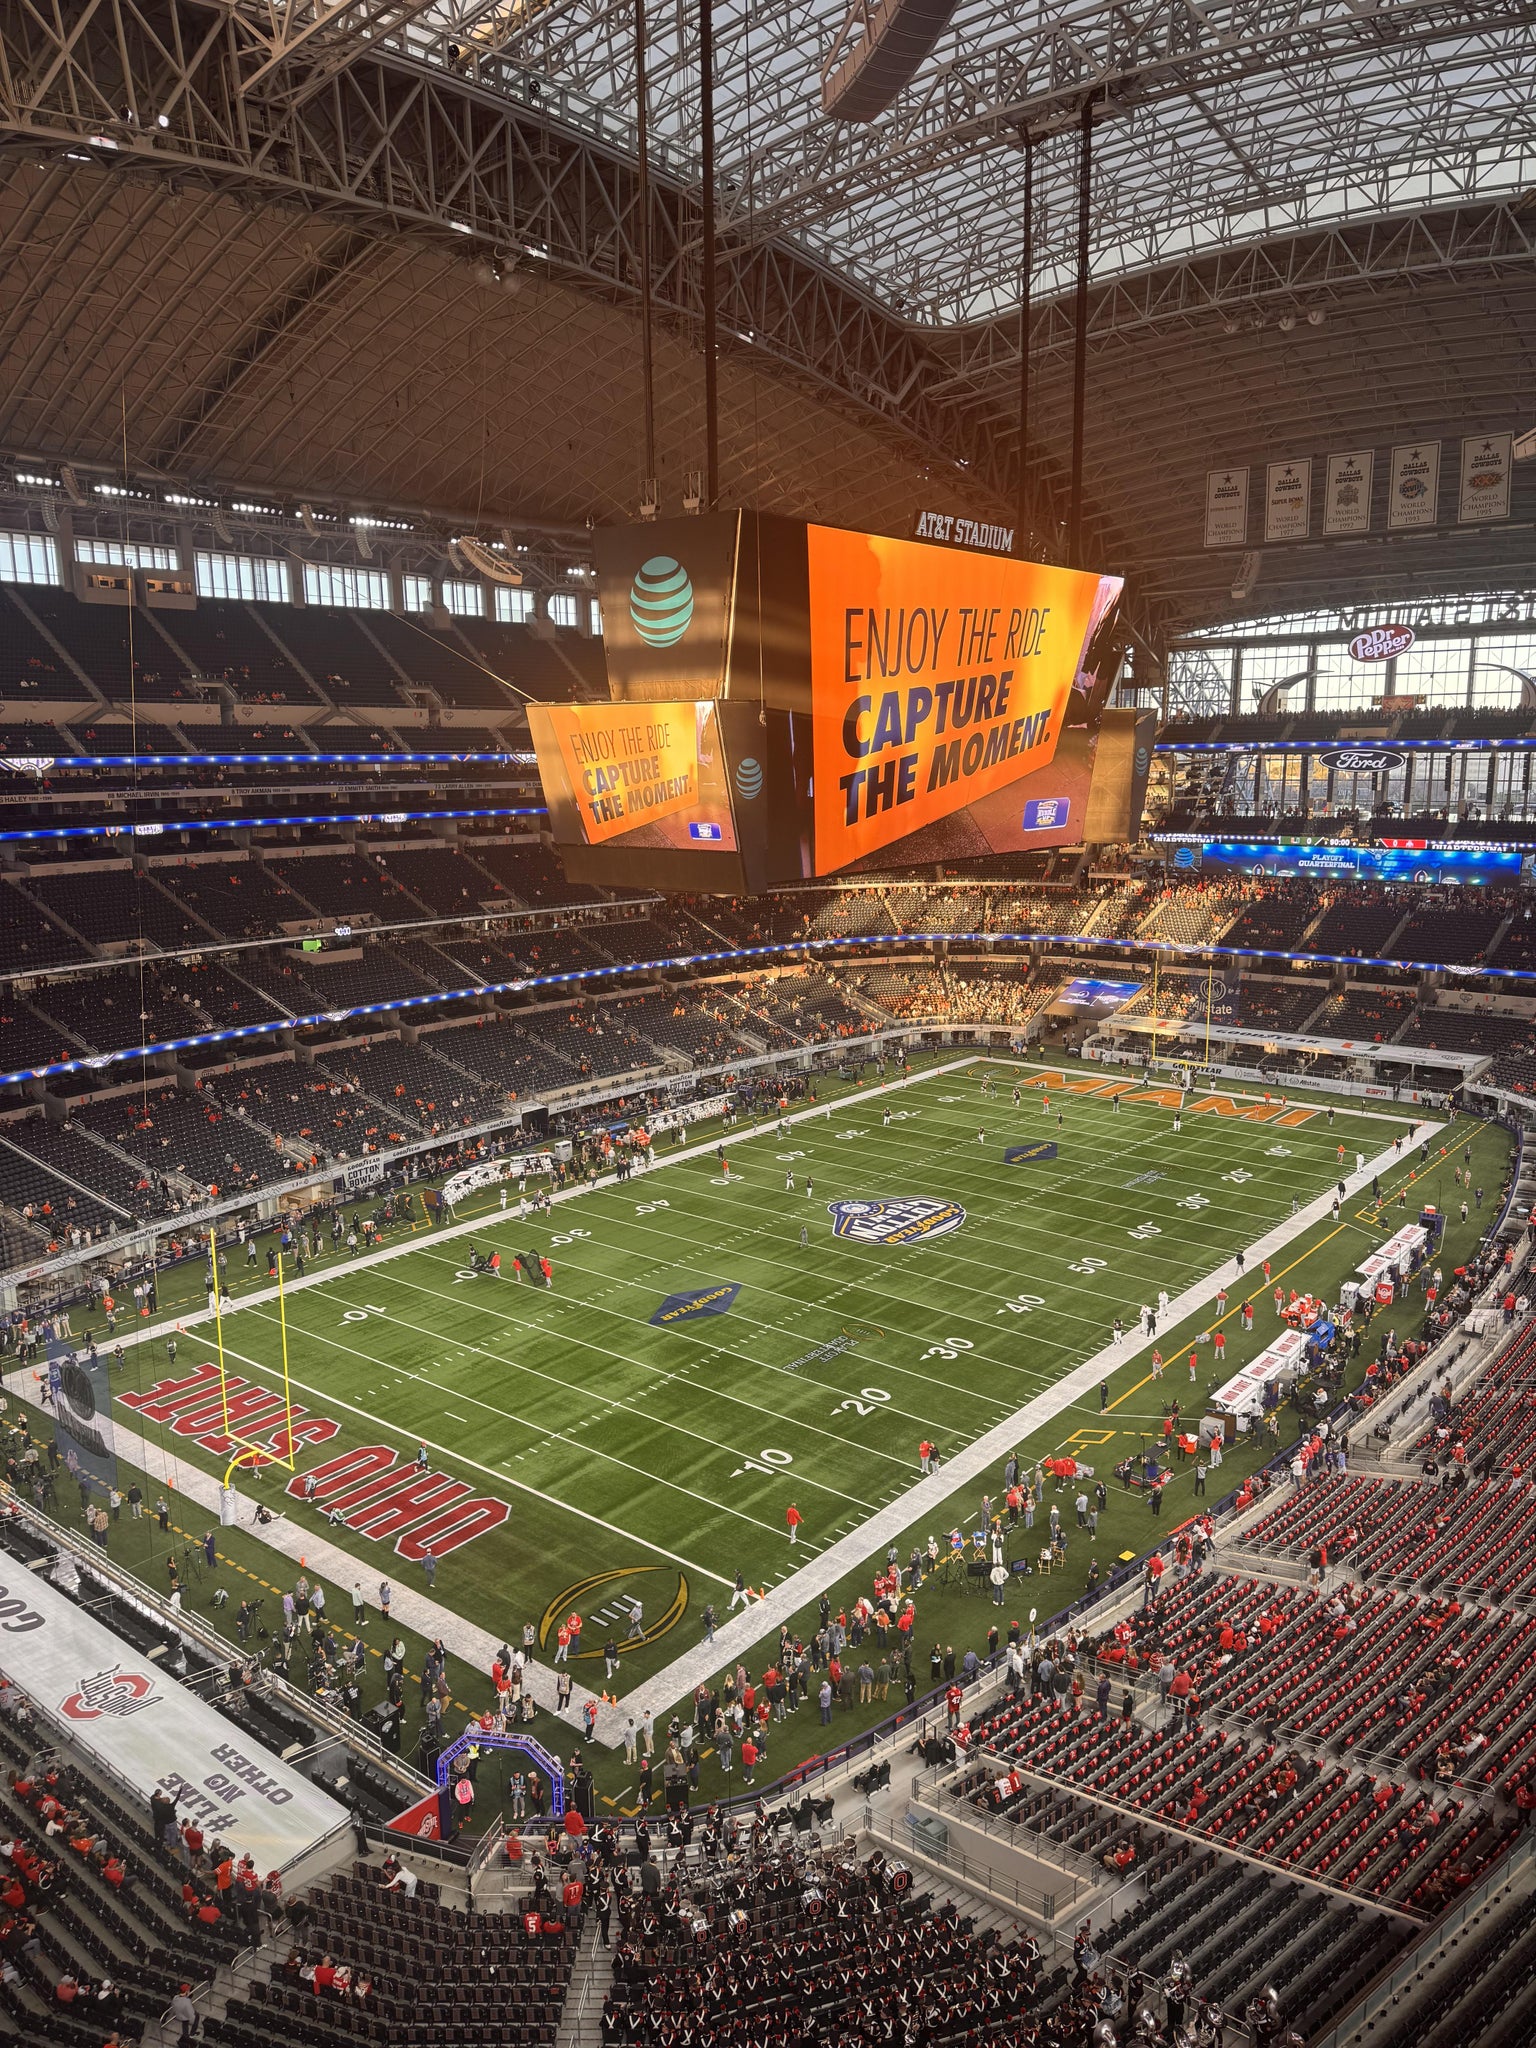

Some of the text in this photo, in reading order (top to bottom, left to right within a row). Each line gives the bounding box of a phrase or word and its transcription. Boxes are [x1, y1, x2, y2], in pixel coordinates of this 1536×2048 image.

[1403, 461, 1427, 469] DALLAS
[1471, 459, 1502, 469] COWBOYS
[1474, 453, 1500, 461] DALLAS
[1335, 476, 1363, 484] COWBOYS
[1400, 468, 1430, 477] COWBOYS
[1214, 491, 1240, 499] COWBOYS
[1275, 484, 1302, 492] COWBOYS
[1400, 501, 1426, 509] WORLD
[1463, 501, 1506, 511] CHAMPIONS
[1471, 494, 1498, 502] WORLD
[1328, 515, 1366, 524] CHAMPIONS
[1392, 508, 1433, 517] CHAMPIONS
[915, 511, 1014, 552] AT&T STADIUM
[1268, 522, 1306, 531] CHAMPIONS
[845, 608, 1050, 682] ENJOY THE RIDE
[1371, 629, 1395, 645] Dr
[1357, 634, 1410, 659] Pepper
[842, 670, 1014, 759] CAPTURE
[569, 723, 671, 765] ENJOY THE RIDE
[839, 709, 1052, 827] THE MOMENT.
[1336, 752, 1387, 769] Ford
[582, 755, 660, 797] CAPTURE
[5, 795, 27, 803] HALEY
[588, 774, 692, 825] THE MOMENT.
[1298, 860, 1356, 869] QUARTERFINAL
[1312, 854, 1344, 862] PLAYOFF
[1192, 1001, 1233, 1016] Allstate
[1216, 1028, 1321, 1045] GOODYEAR
[1299, 1080, 1321, 1088] Allstate
[1366, 1088, 1386, 1096] ESPN
[1018, 1071, 1321, 1127] MIAMI
[1264, 1147, 1292, 1157] 10
[347, 1157, 381, 1171] GOODYEAR
[347, 1164, 380, 1180] COTTON
[349, 1175, 374, 1187] BOWL
[709, 1173, 746, 1187] 50
[1221, 1170, 1253, 1183] 20
[635, 1199, 671, 1213] 40
[1176, 1195, 1210, 1210] 30
[850, 1200, 947, 1240] COTTON
[854, 1202, 911, 1226] BOWL
[884, 1207, 960, 1244] GOODYEAR
[1127, 1223, 1162, 1240] 40
[129, 1226, 162, 1242] GOODYEAR
[552, 1228, 593, 1244] 30
[26, 1267, 45, 1278] ESPN
[1067, 1257, 1108, 1274] 50
[660, 1287, 733, 1322] GOODYEAR
[1006, 1294, 1046, 1315] 40
[343, 1304, 387, 1322] 10
[782, 1335, 847, 1371] QUARTERFINAL
[818, 1339, 860, 1364] PLAYOFF
[927, 1337, 974, 1361] 30
[1249, 1366, 1267, 1377] OHIO
[1221, 1379, 1252, 1402] OHIO STATE
[840, 1387, 892, 1416] 20
[113, 1362, 343, 1469] STATE
[744, 1448, 793, 1475] 10
[284, 1444, 512, 1562] OHIO
[951, 1696, 961, 1704] 47
[210, 1742, 294, 1806] OTHER
[1014, 1776, 1020, 1788] 1
[202, 1773, 248, 1804] NO
[155, 1771, 239, 1833] #LIKE
[528, 1919, 537, 1933] 5
